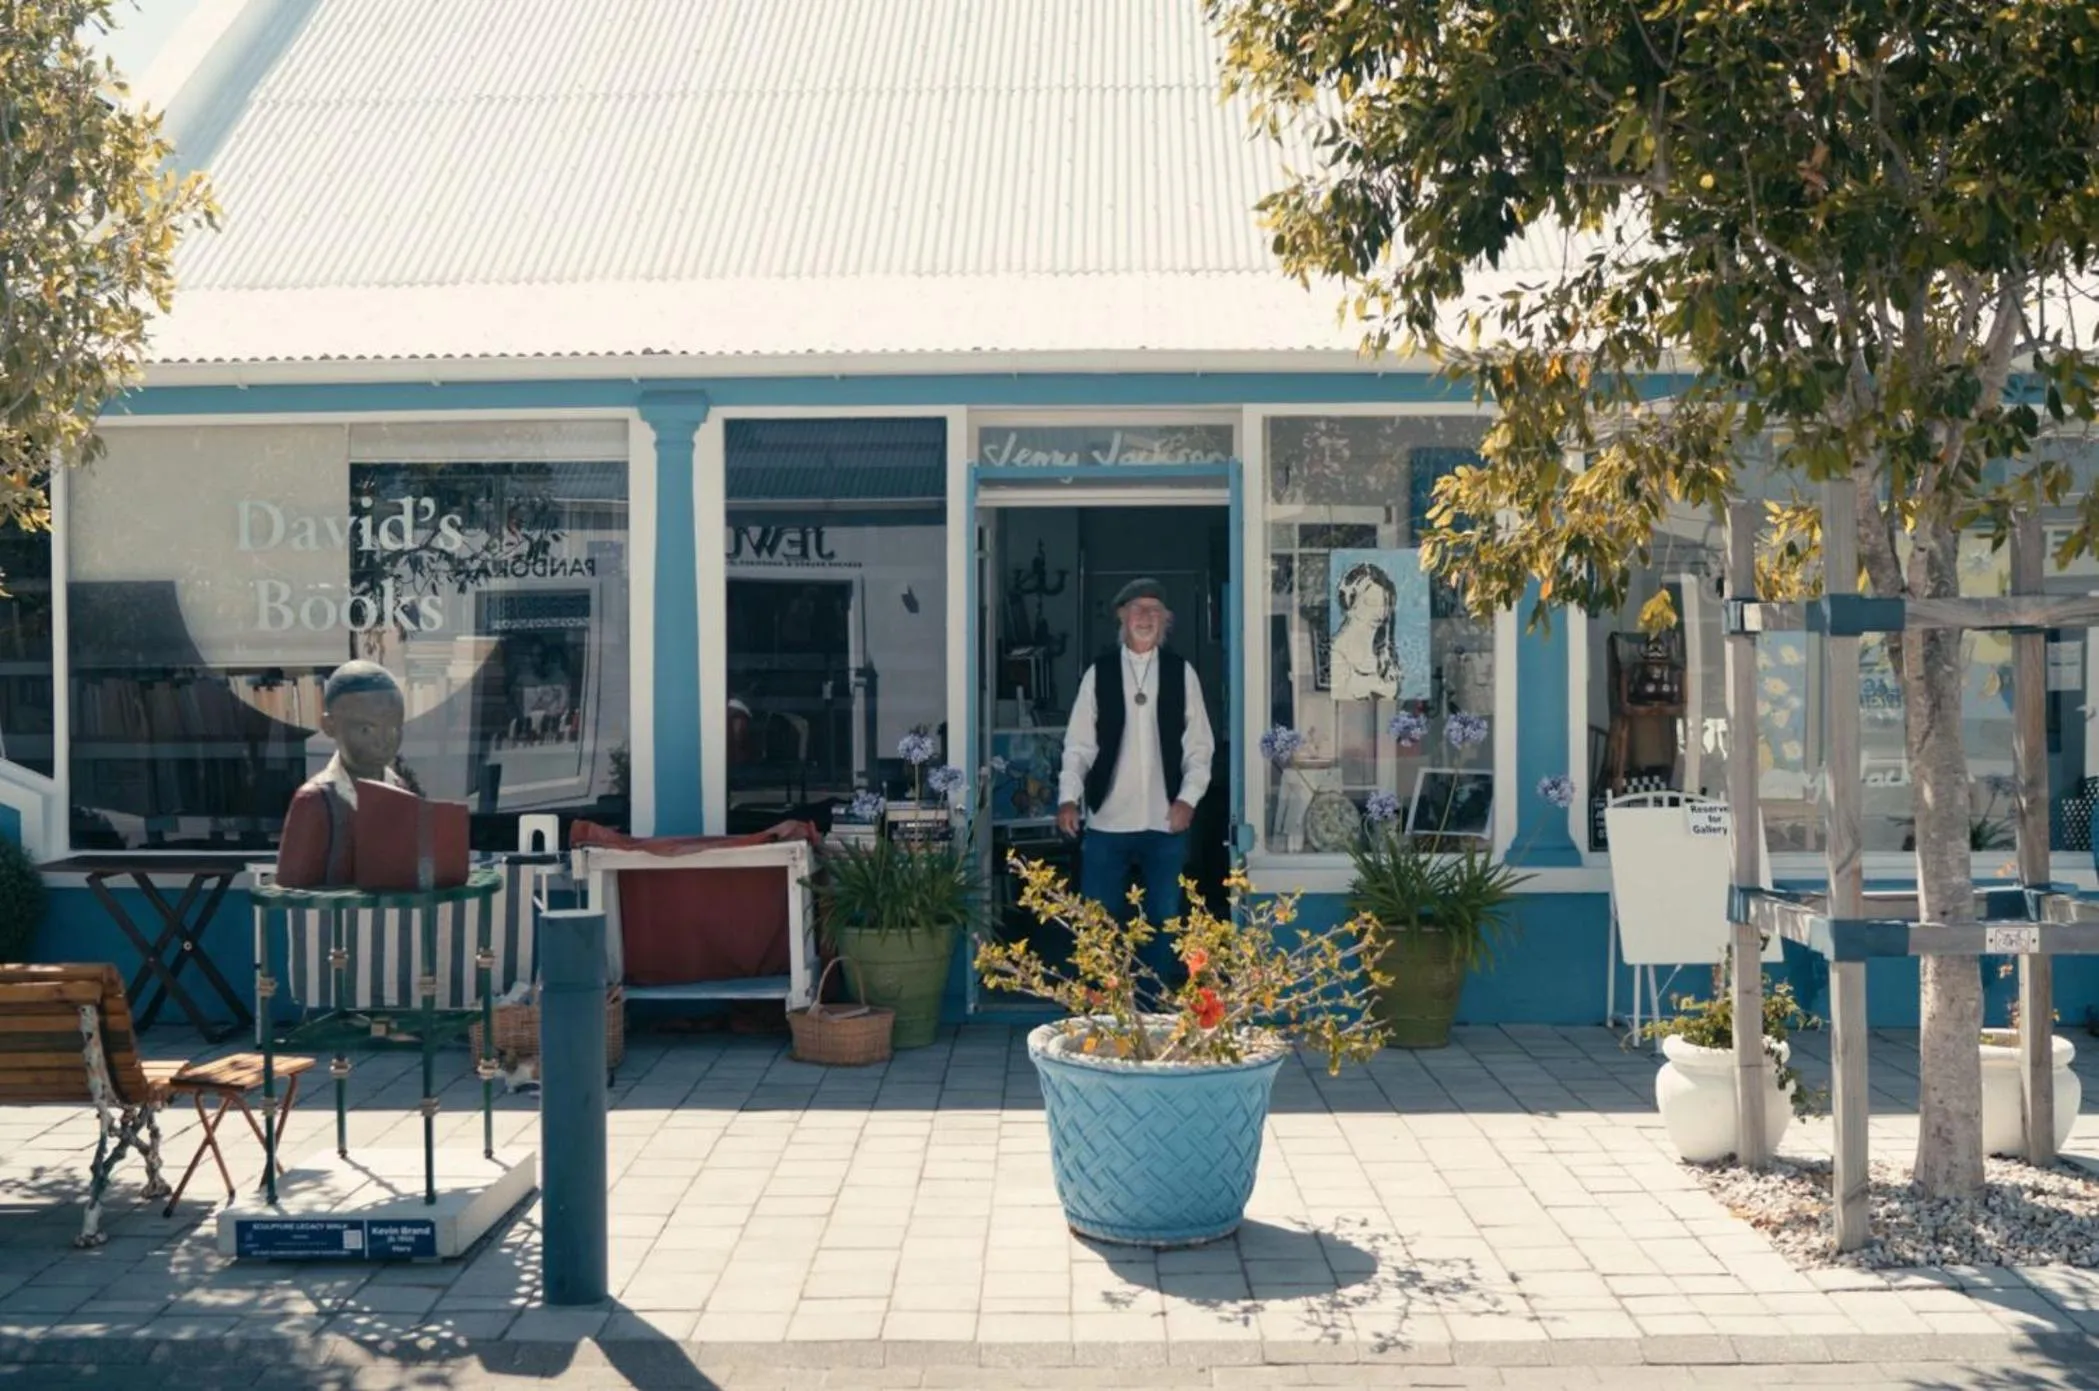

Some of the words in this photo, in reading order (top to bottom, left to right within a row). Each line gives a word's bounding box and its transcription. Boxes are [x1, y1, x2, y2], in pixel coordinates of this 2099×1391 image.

[236, 495, 462, 551] David's
[256, 577, 443, 632] Books
[1708, 815, 1721, 823] for
[1693, 825, 1728, 836] Gallery
[371, 1226, 398, 1235] Kevin
